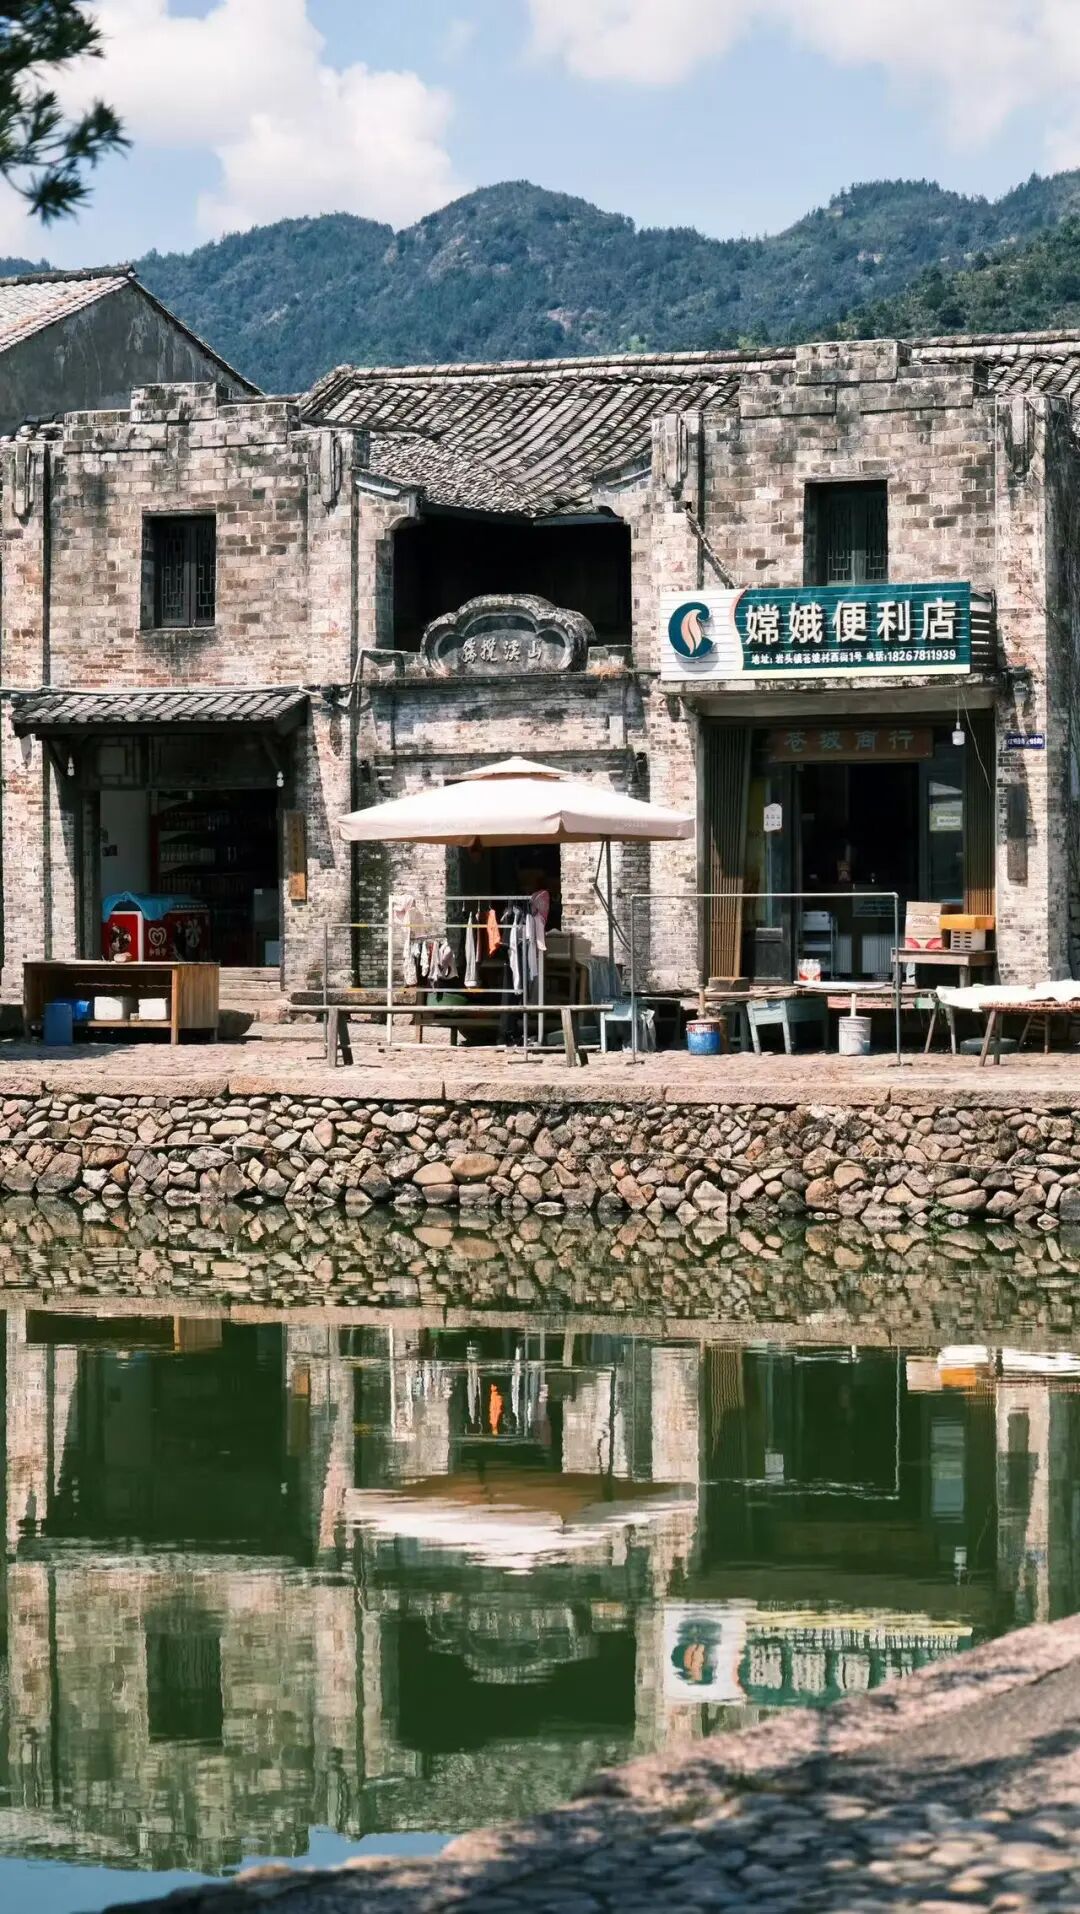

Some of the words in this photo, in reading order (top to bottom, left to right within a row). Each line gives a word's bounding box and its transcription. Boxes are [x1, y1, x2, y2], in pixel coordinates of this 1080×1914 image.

[745, 598, 956, 646] 嫦娥便利店
